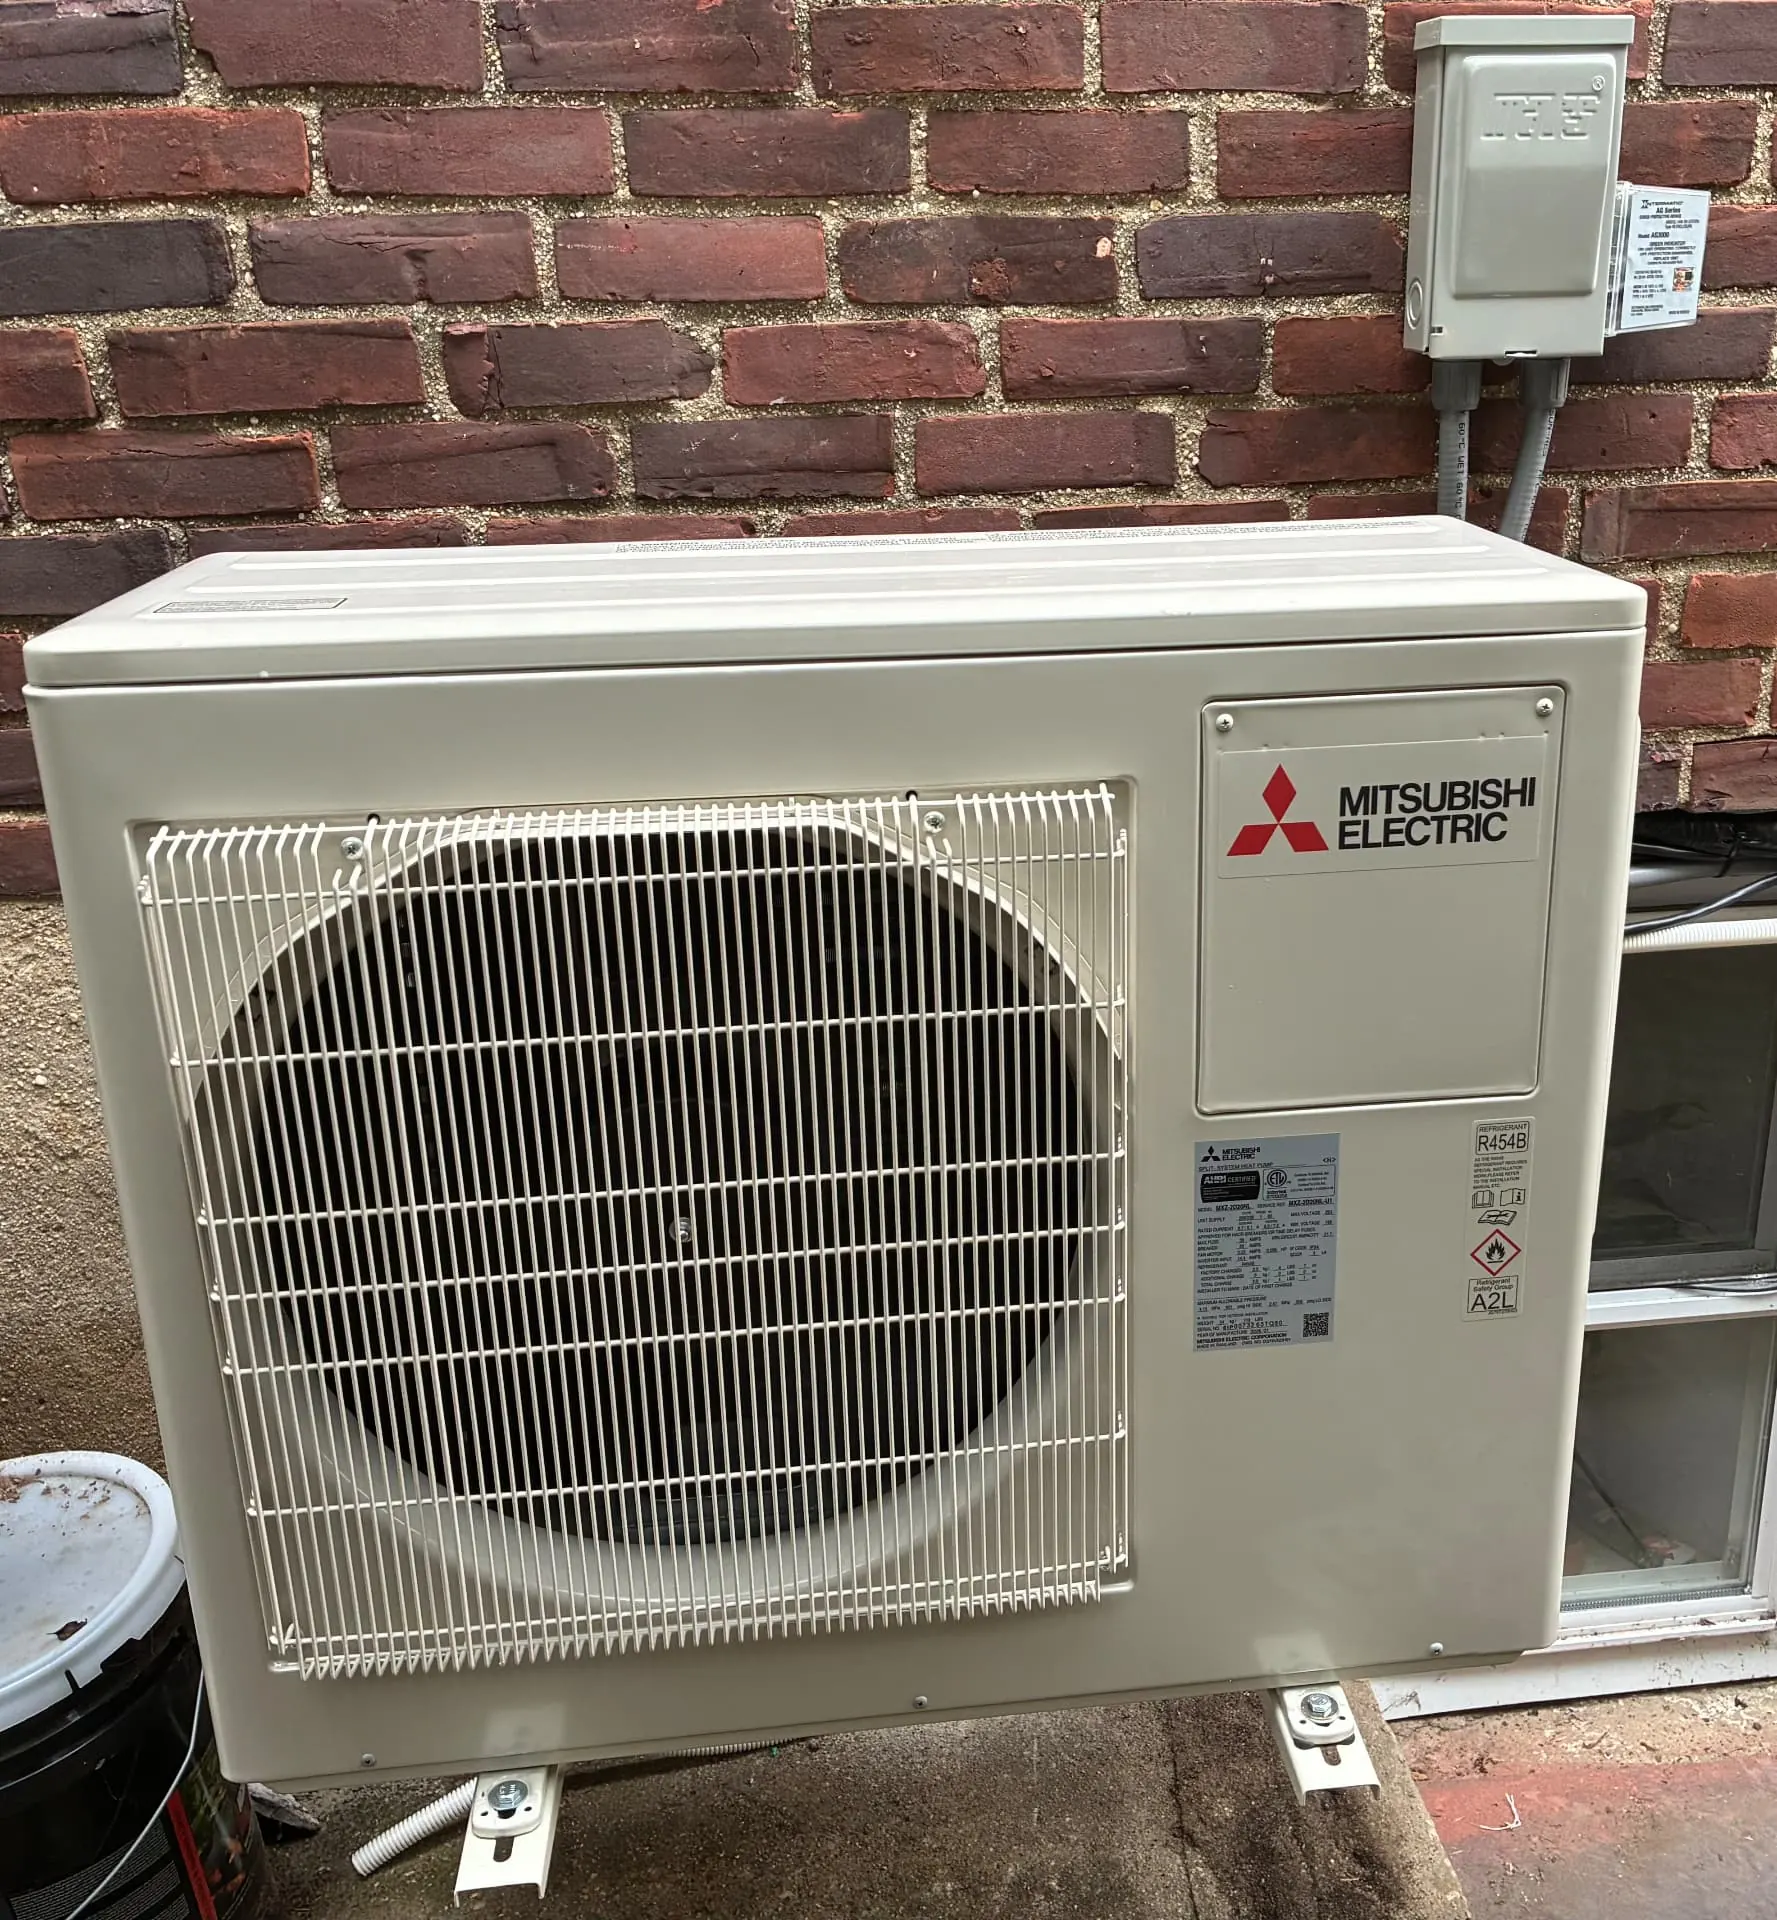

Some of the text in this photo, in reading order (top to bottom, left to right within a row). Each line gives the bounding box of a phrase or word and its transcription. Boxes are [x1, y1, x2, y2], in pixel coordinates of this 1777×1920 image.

[1457, 455, 1465, 474] WET
[1339, 777, 1536, 817] MITSUBISHI
[1338, 812, 1508, 850] ELECTRIC
[1479, 1123, 1527, 1132] REFRIGERANT
[1223, 1147, 1260, 1155] MITSUBISHI
[1478, 1132, 1526, 1151] R454B
[1476, 1278, 1510, 1286] Refrigerant
[1471, 1292, 1514, 1311] A2L
